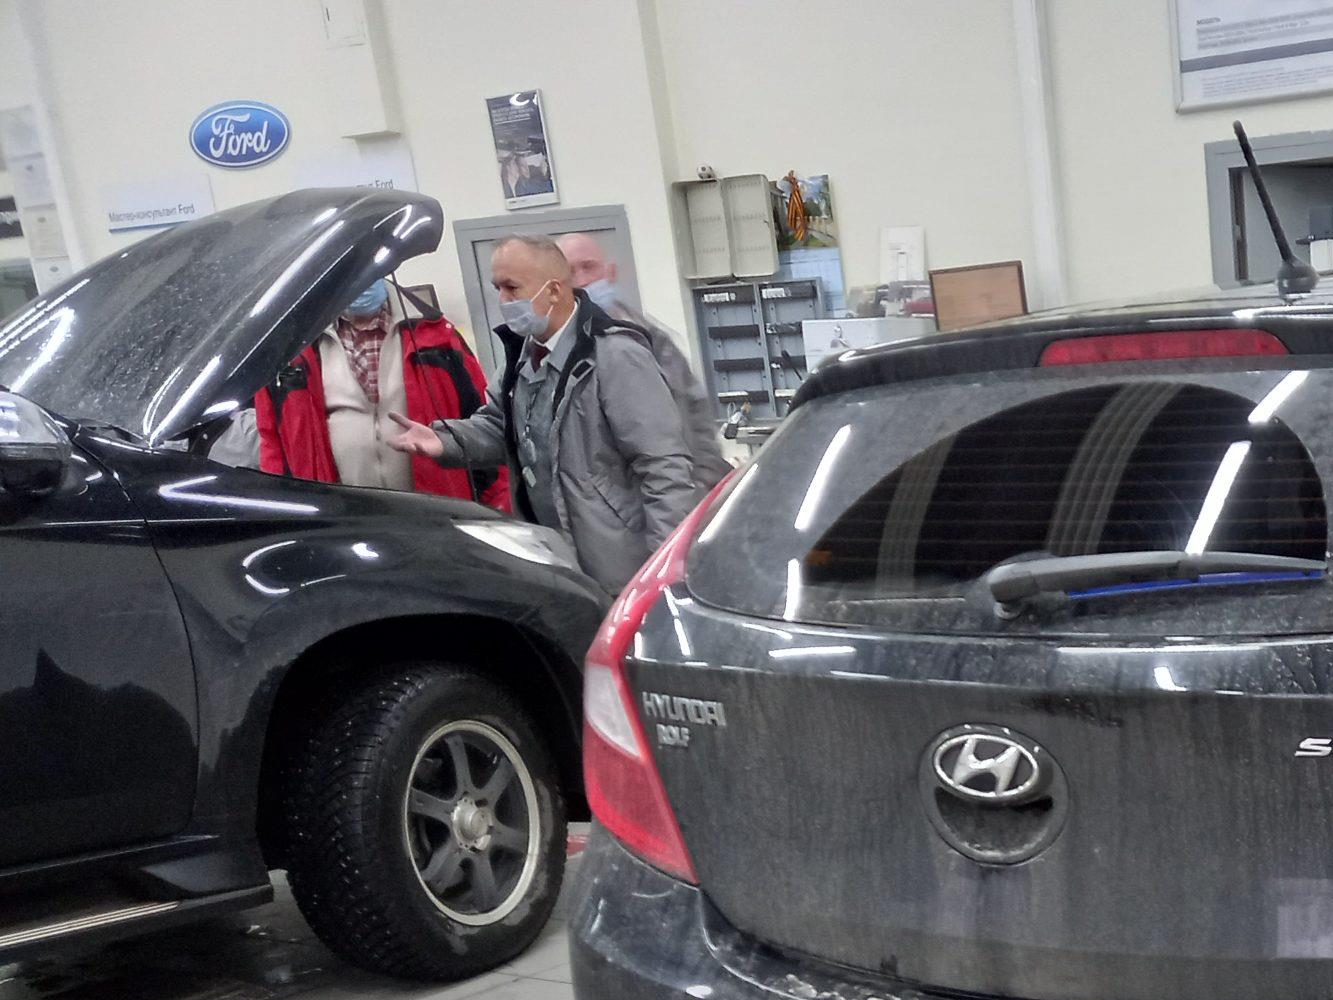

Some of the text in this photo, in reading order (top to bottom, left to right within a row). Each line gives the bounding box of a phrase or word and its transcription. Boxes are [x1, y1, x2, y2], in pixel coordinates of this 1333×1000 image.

[209, 112, 271, 158] Ford
[178, 203, 195, 216] Ford
[642, 691, 727, 727] HYUNDAI
